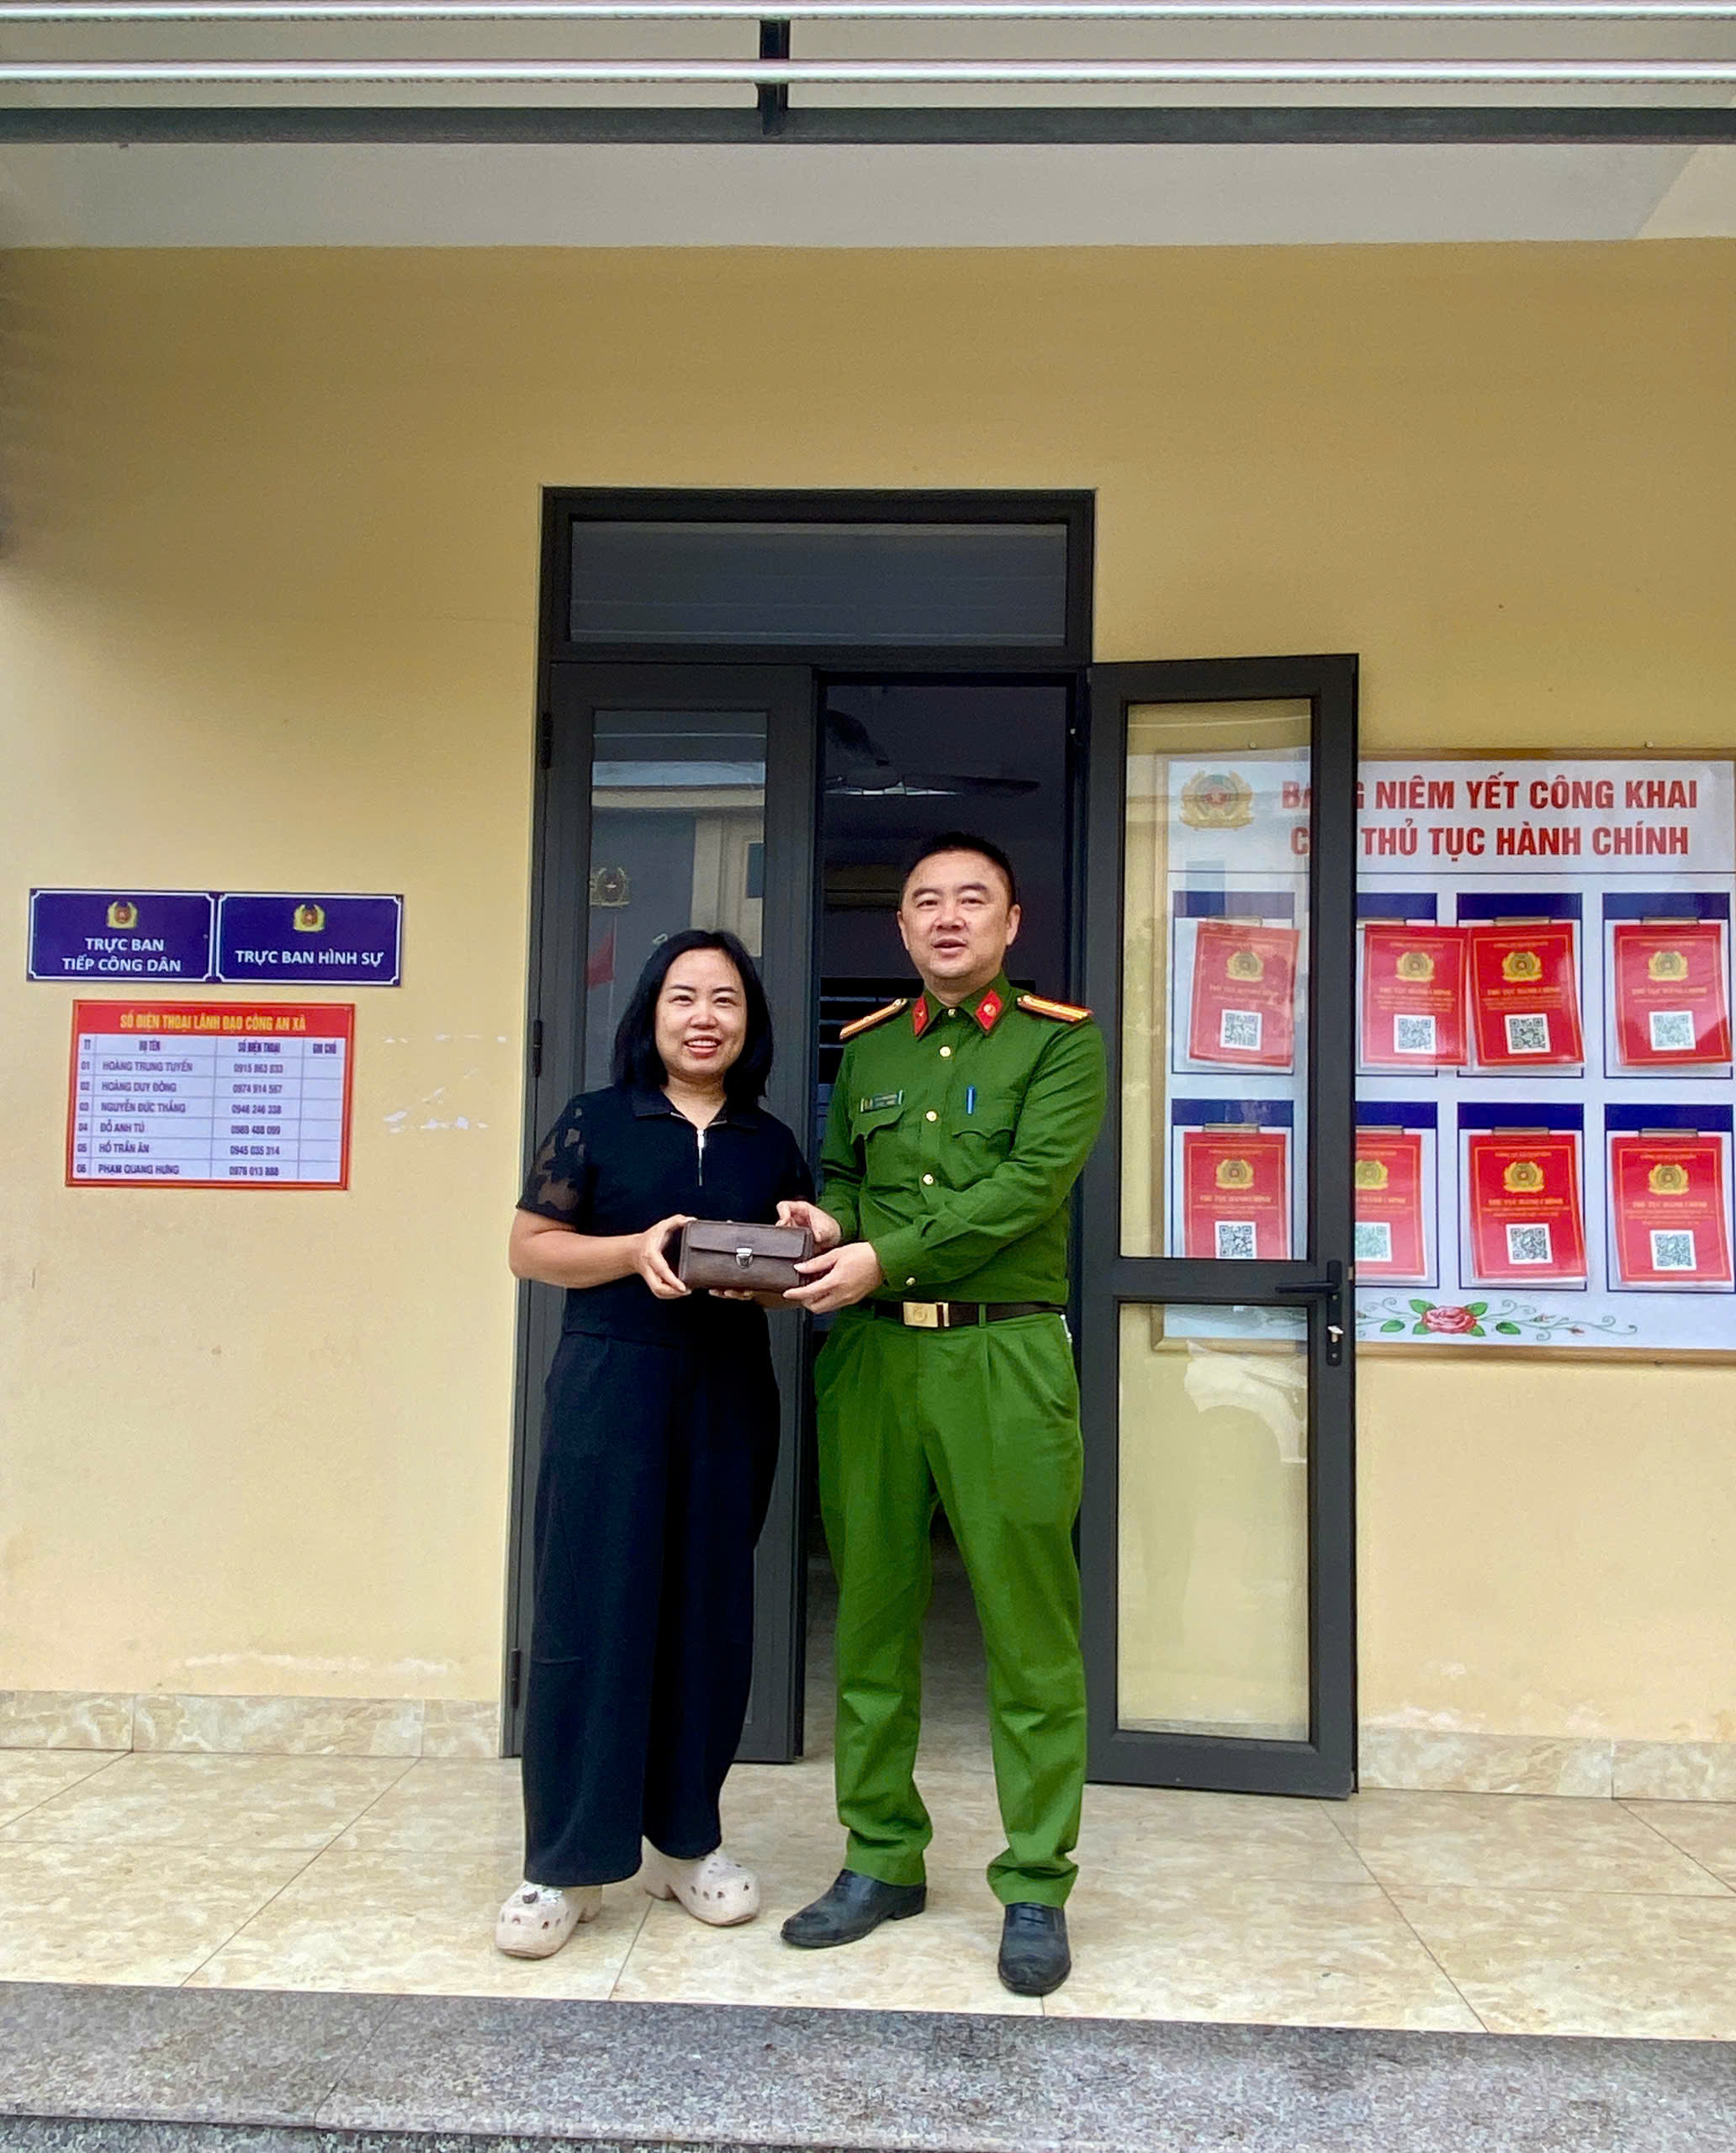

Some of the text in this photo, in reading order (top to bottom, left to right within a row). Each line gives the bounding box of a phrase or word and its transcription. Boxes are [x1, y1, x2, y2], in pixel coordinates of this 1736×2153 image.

[1375, 775, 1454, 809] NIÊM
[1466, 771, 1519, 809] YẾT
[1529, 775, 1614, 809] CÔNG
[1625, 780, 1697, 809] KHAI
[1361, 818, 1689, 862] THỦ TỤC HÀNH CHÍNH
[85, 937, 165, 953] TRỰC BAN
[62, 955, 181, 971] TIẾP CÔNG DÂN
[236, 948, 384, 967] TRỰC BAN HÌNH SỰ
[120, 1010, 134, 1029] SỐ
[162, 1013, 192, 1032] THOẠI
[246, 1013, 273, 1031] CÔNG
[275, 1016, 290, 1031] AN
[81, 1061, 90, 1070] 01
[135, 1061, 163, 1071] TRUNG
[114, 1123, 131, 1132] ANH
[124, 1164, 153, 1174] QUANG
